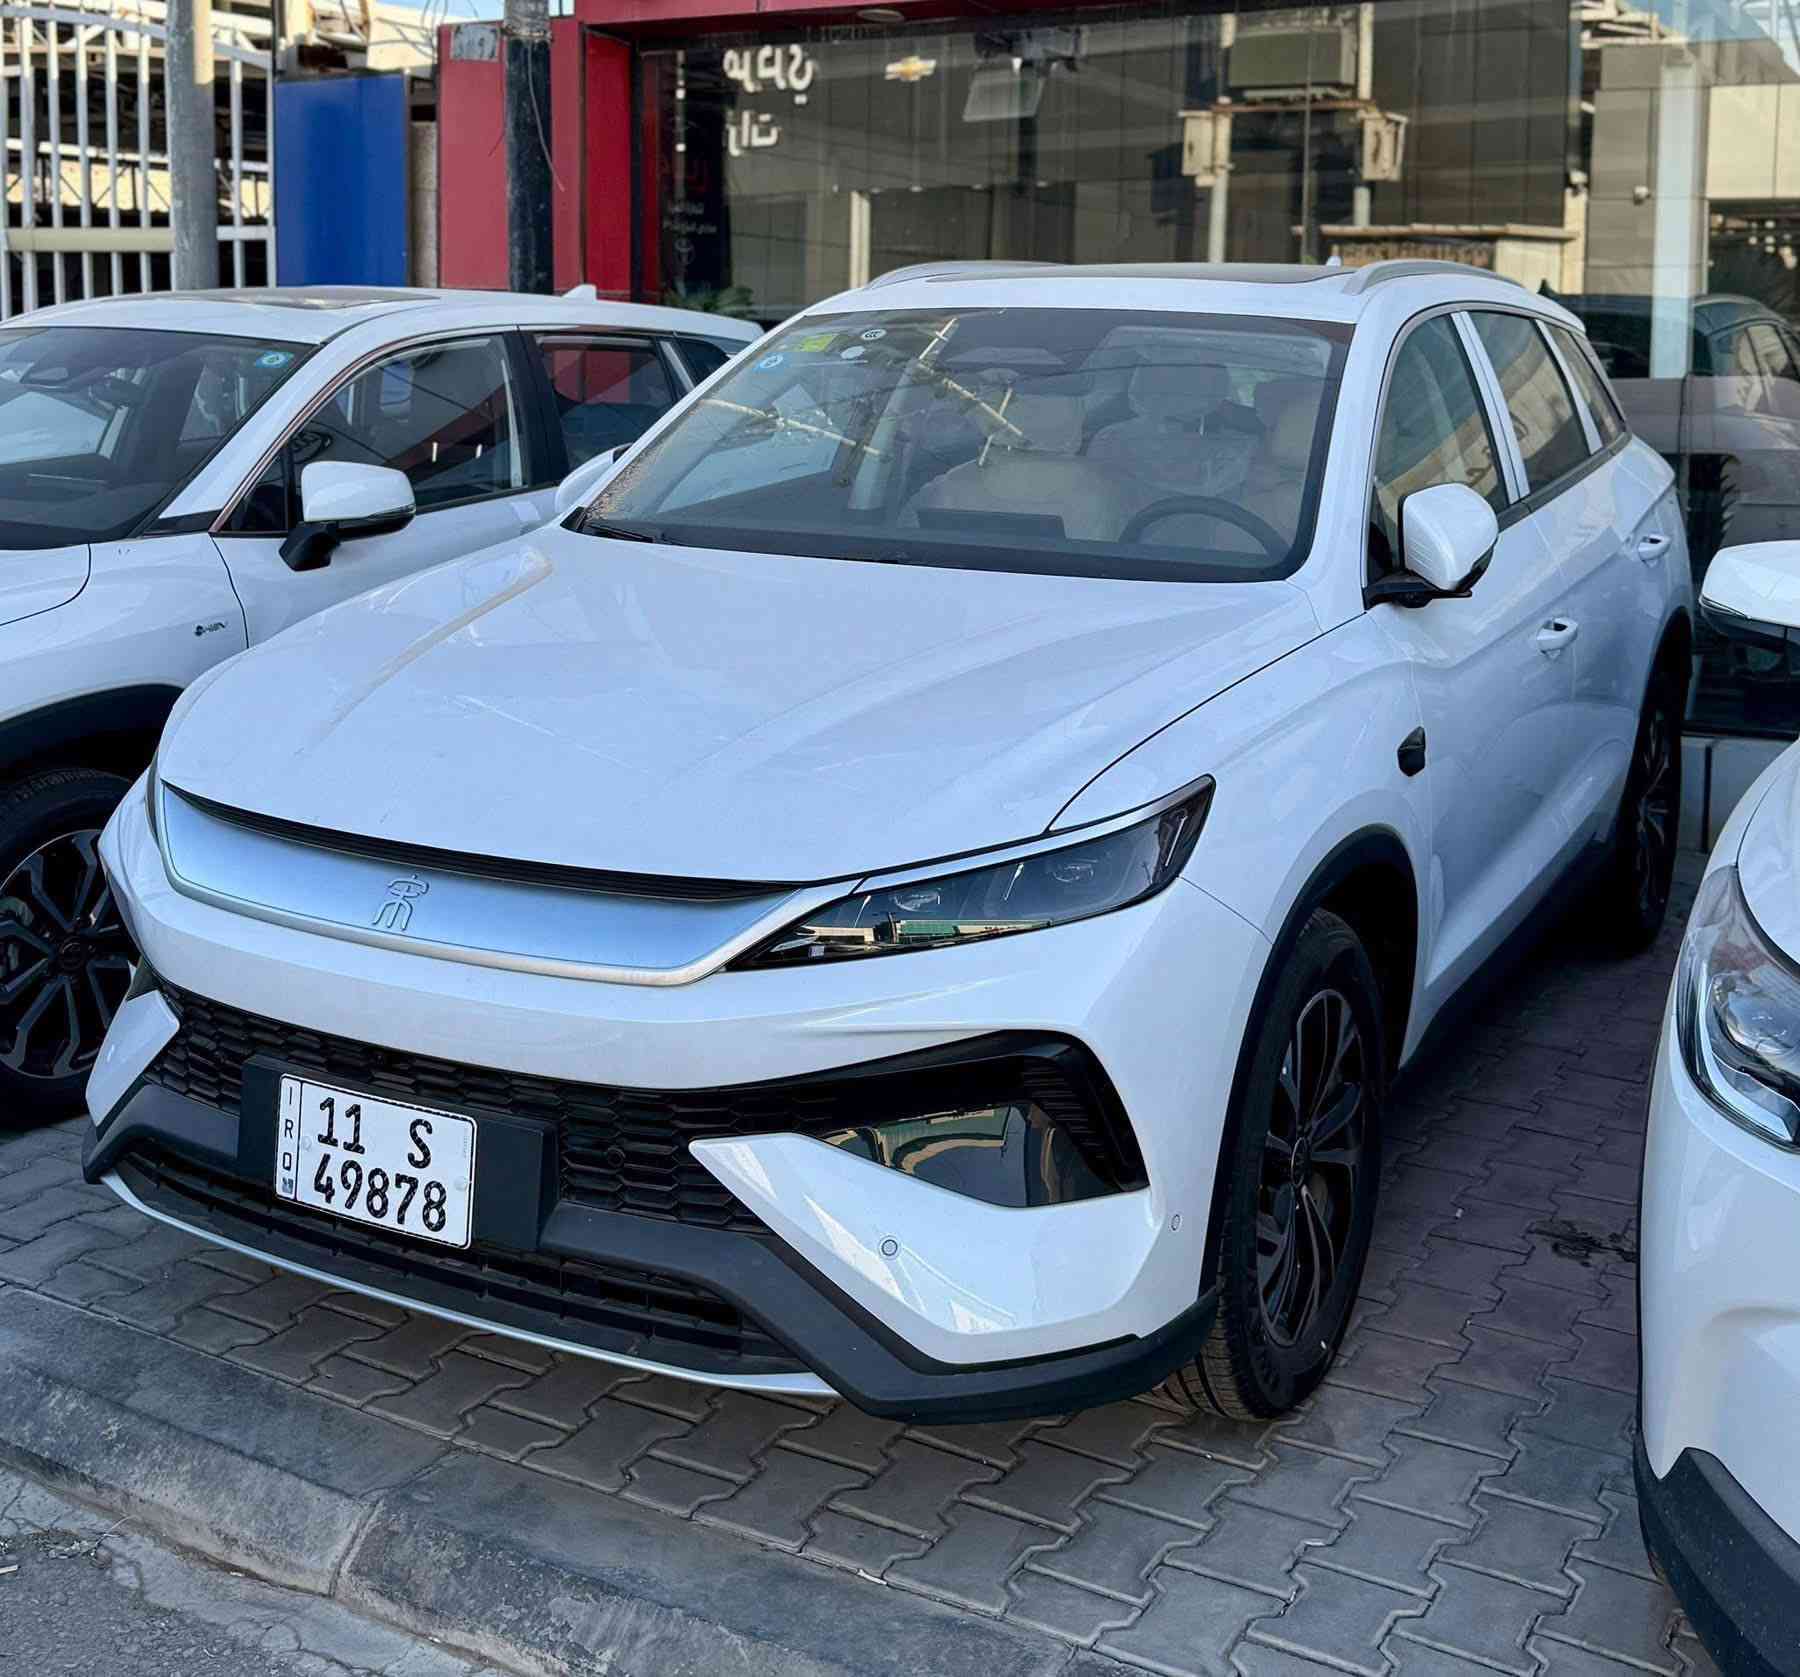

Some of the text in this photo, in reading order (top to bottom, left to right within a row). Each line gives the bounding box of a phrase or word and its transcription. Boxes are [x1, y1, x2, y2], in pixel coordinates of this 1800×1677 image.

[317, 1097, 365, 1155] 11
[407, 1118, 434, 1169] S
[314, 1153, 447, 1232] 49878
